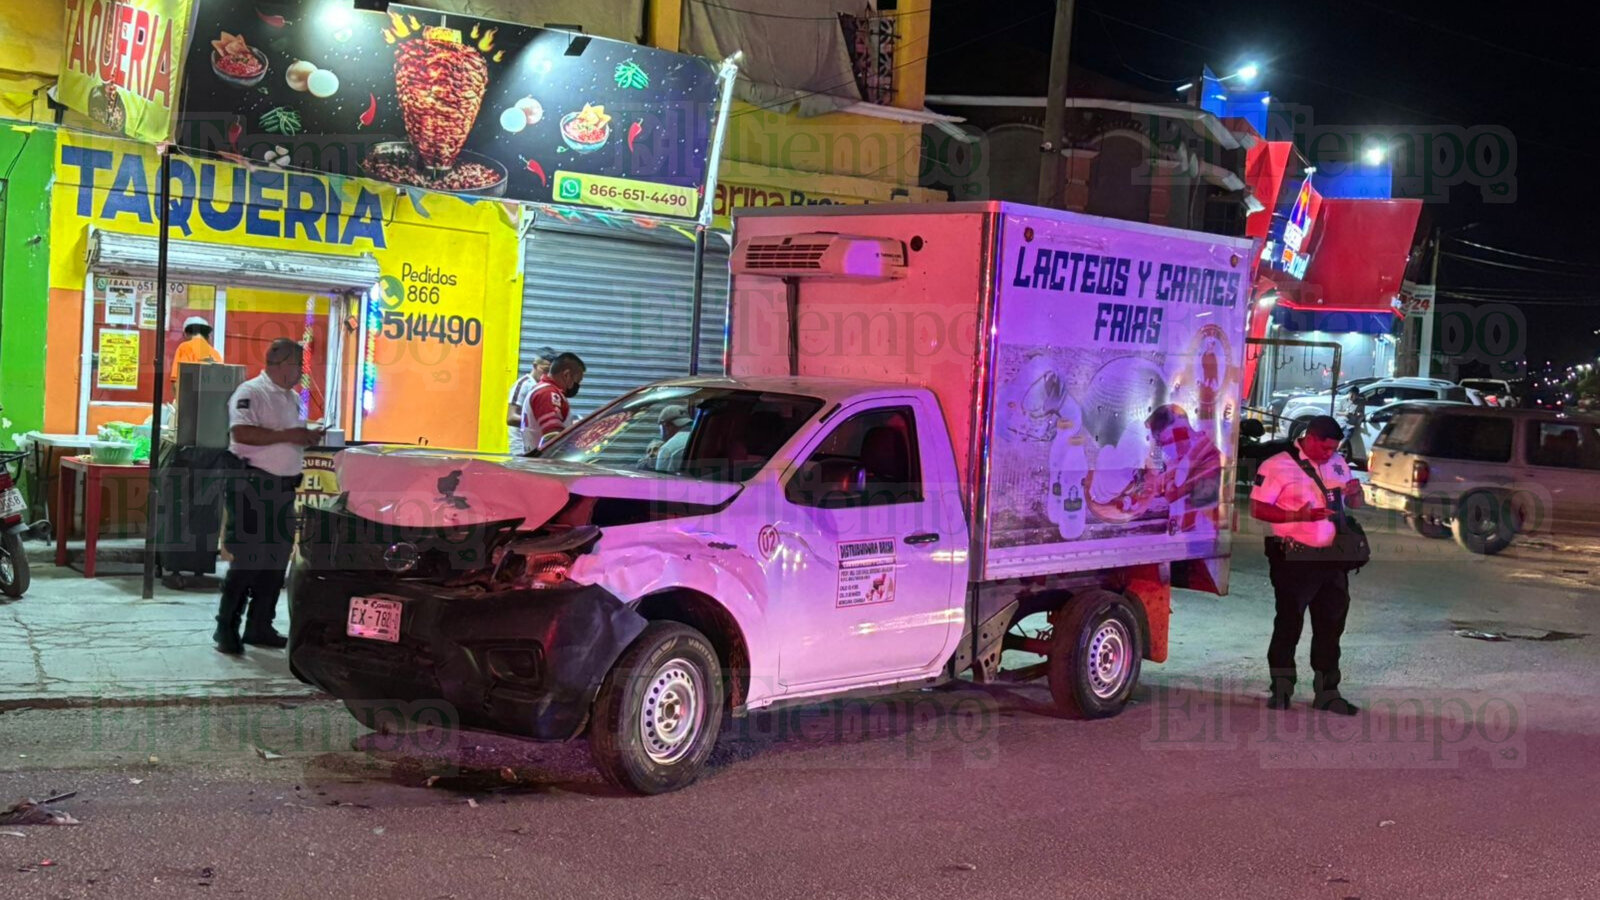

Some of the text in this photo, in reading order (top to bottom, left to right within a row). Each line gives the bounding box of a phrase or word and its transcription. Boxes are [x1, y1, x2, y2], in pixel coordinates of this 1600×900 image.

[66, 0, 171, 109] TAQUERIA
[61, 144, 386, 249] TAQUERIA
[590, 184, 687, 207] 866-651-4490
[713, 183, 785, 216] arina
[402, 262, 457, 286] Pedidos
[1013, 246, 1131, 296] LACTEOS
[1138, 261, 1152, 298] Y
[1156, 263, 1240, 307] CARNES
[407, 285, 440, 305] 866
[1093, 302, 1163, 344] FRIAS
[304, 474, 322, 490] EL
